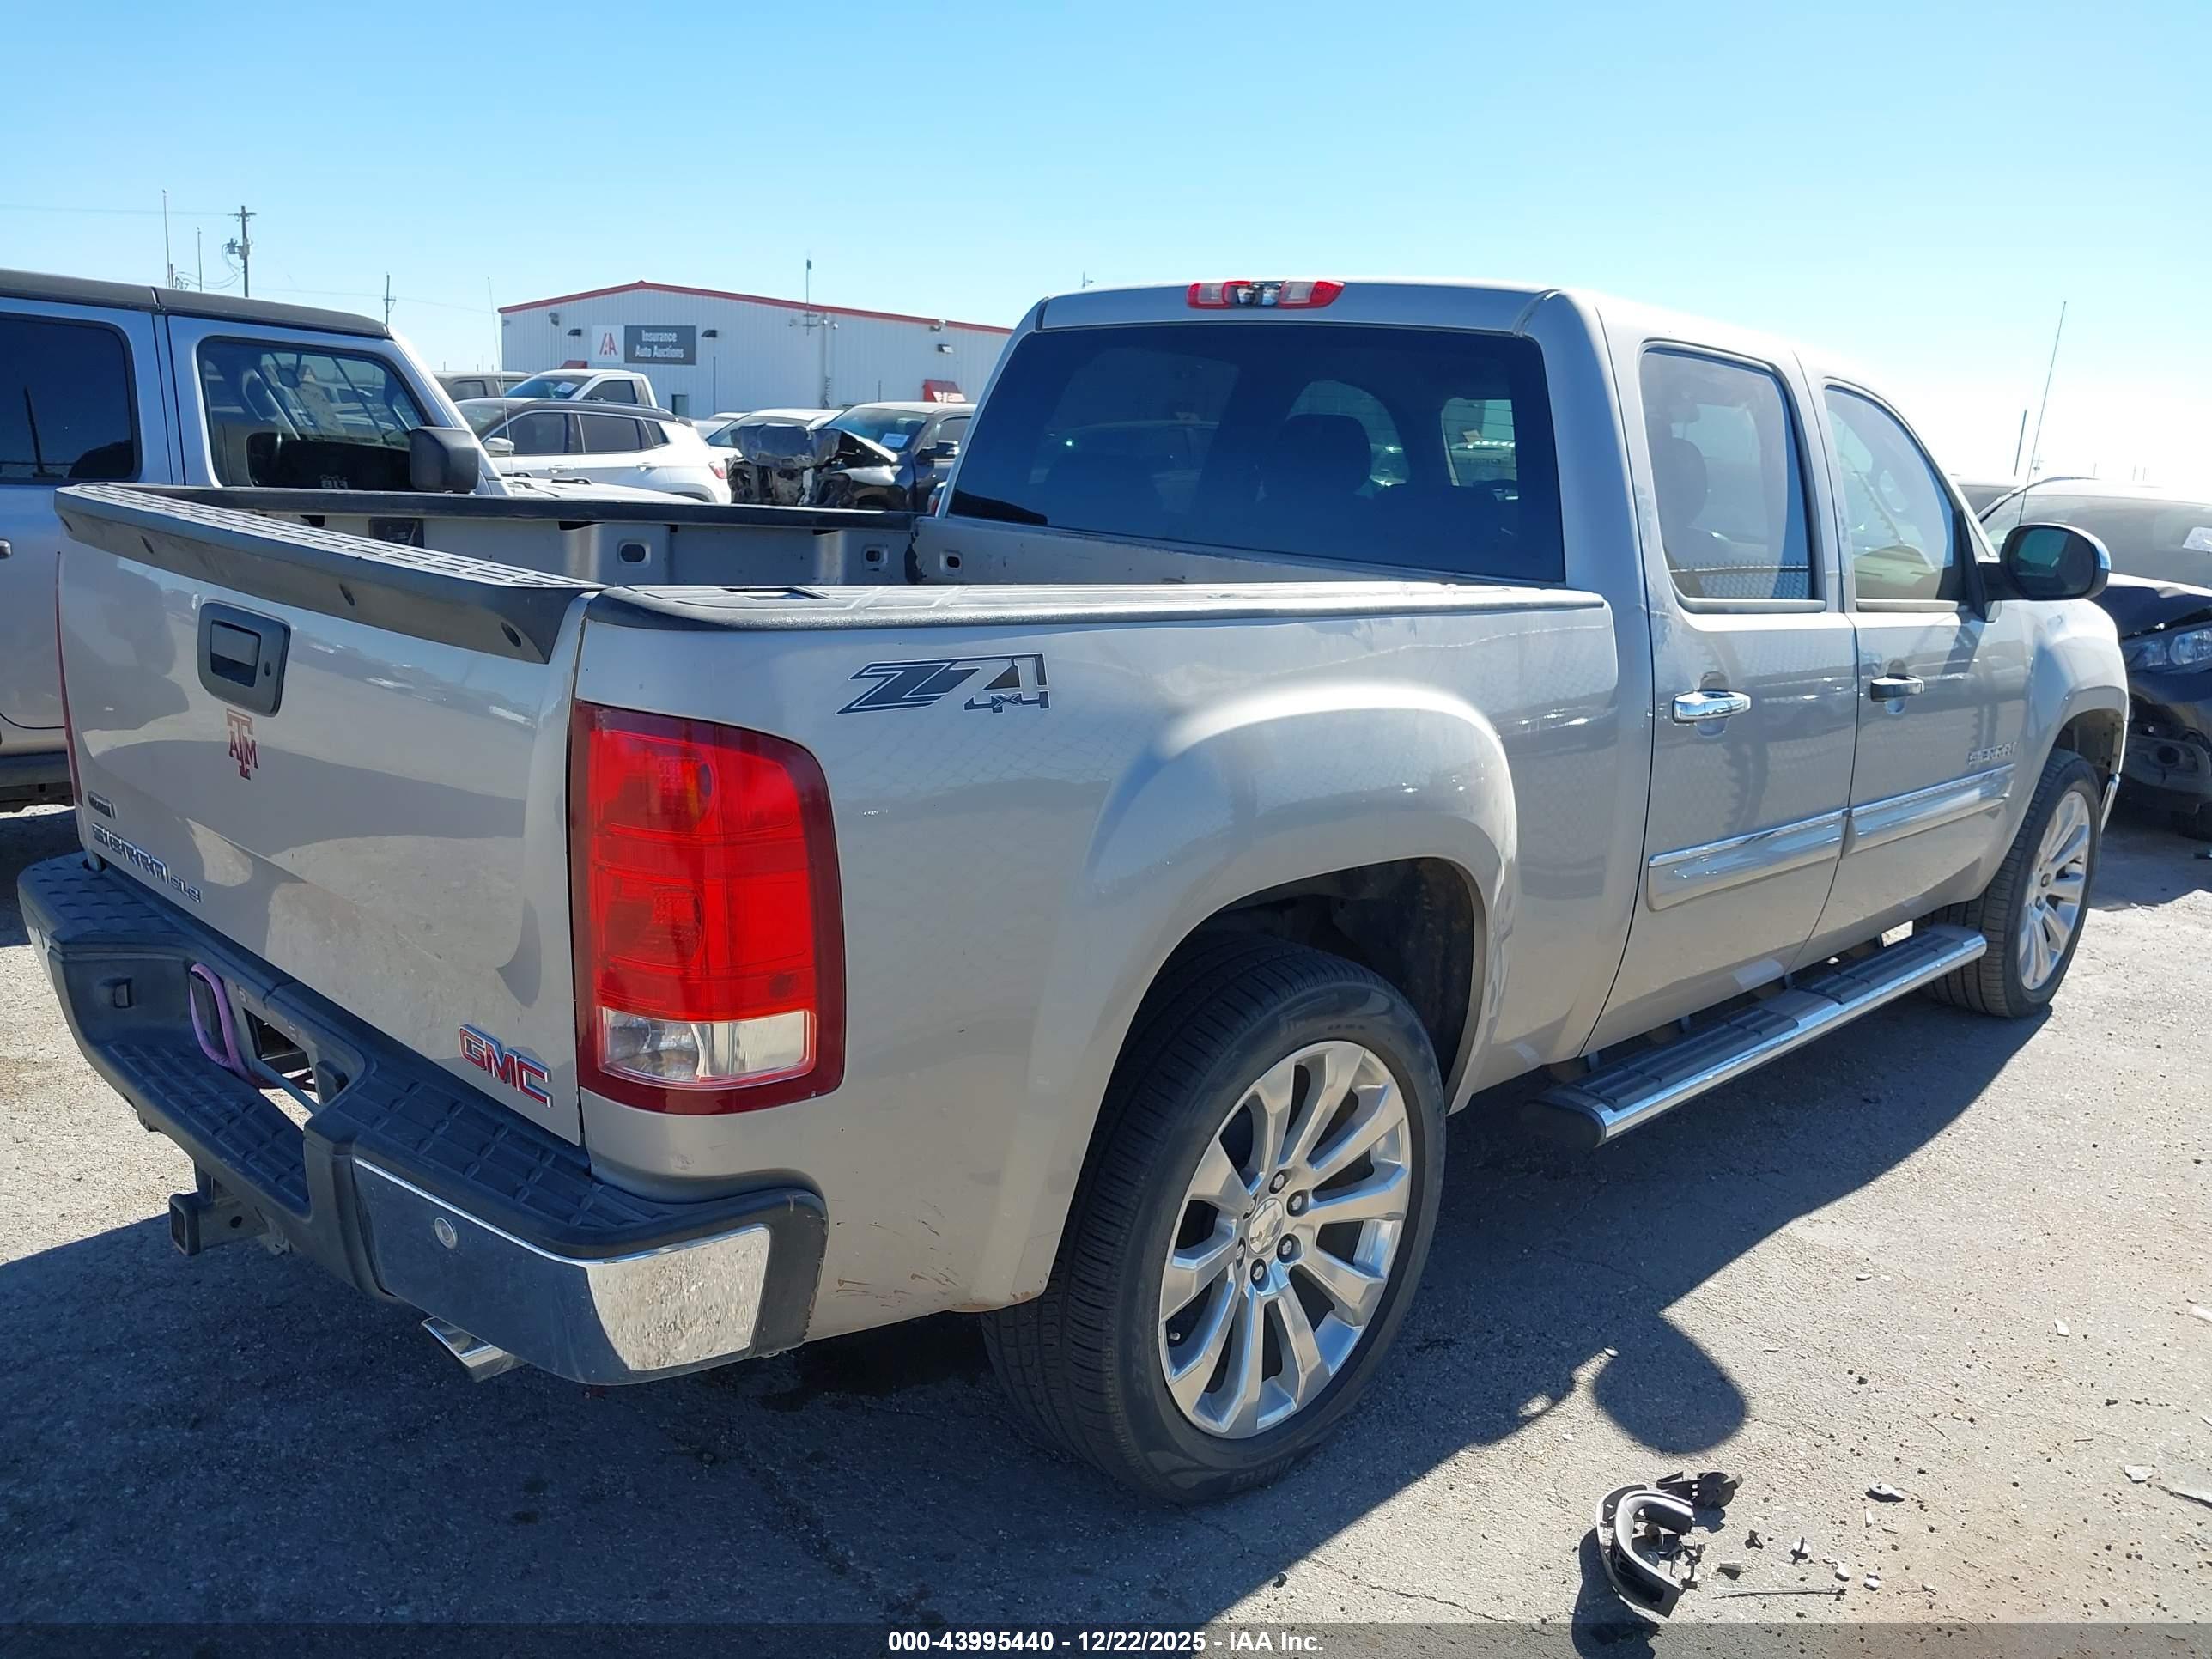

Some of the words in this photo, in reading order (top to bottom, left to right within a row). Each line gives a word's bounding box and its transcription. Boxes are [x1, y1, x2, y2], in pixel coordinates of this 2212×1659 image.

[635, 344, 652, 358] Auto
[653, 344, 684, 359] Auctions
[641, 329, 678, 343] Insurance
[835, 652, 1048, 715] Z71
[1967, 741, 2017, 766] SIERRA
[91, 822, 171, 884] SIERRA
[171, 873, 202, 903] SLE
[459, 1024, 554, 1109] GMC
